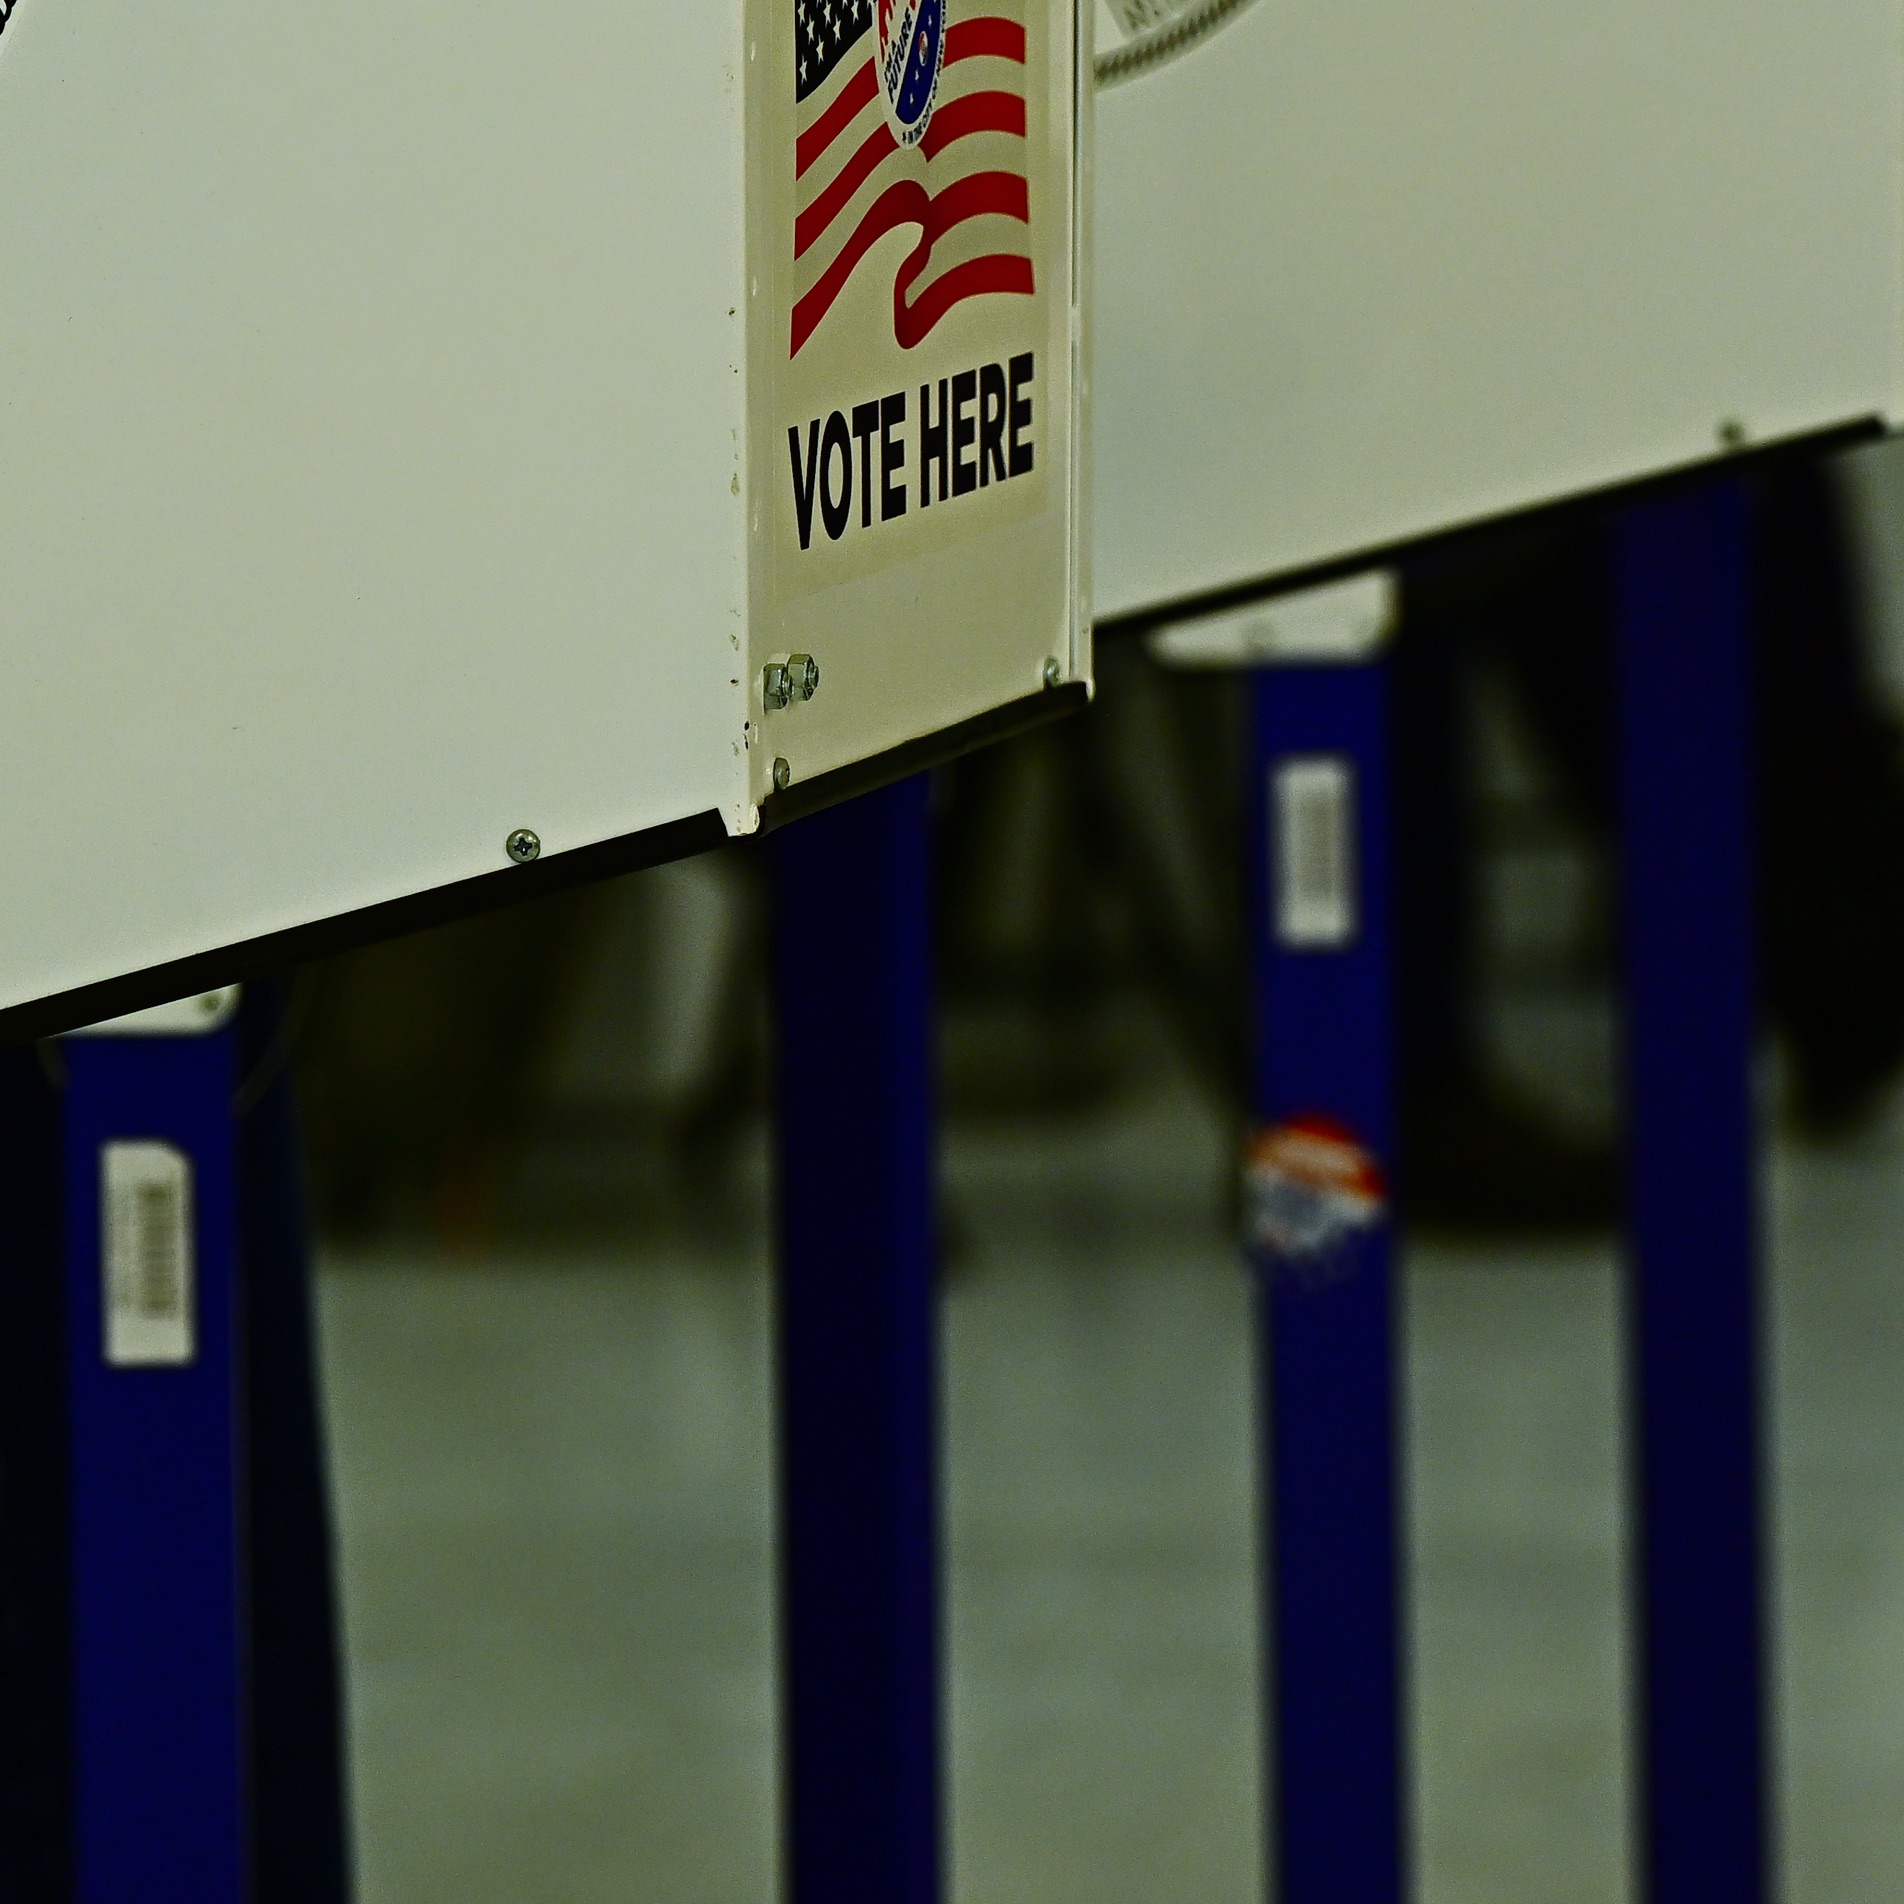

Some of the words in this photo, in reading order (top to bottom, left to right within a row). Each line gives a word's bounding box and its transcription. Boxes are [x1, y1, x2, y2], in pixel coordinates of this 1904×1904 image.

[887, 6, 913, 104] FUTURE
[788, 391, 907, 551] VOTE
[919, 351, 1034, 508] HERE
